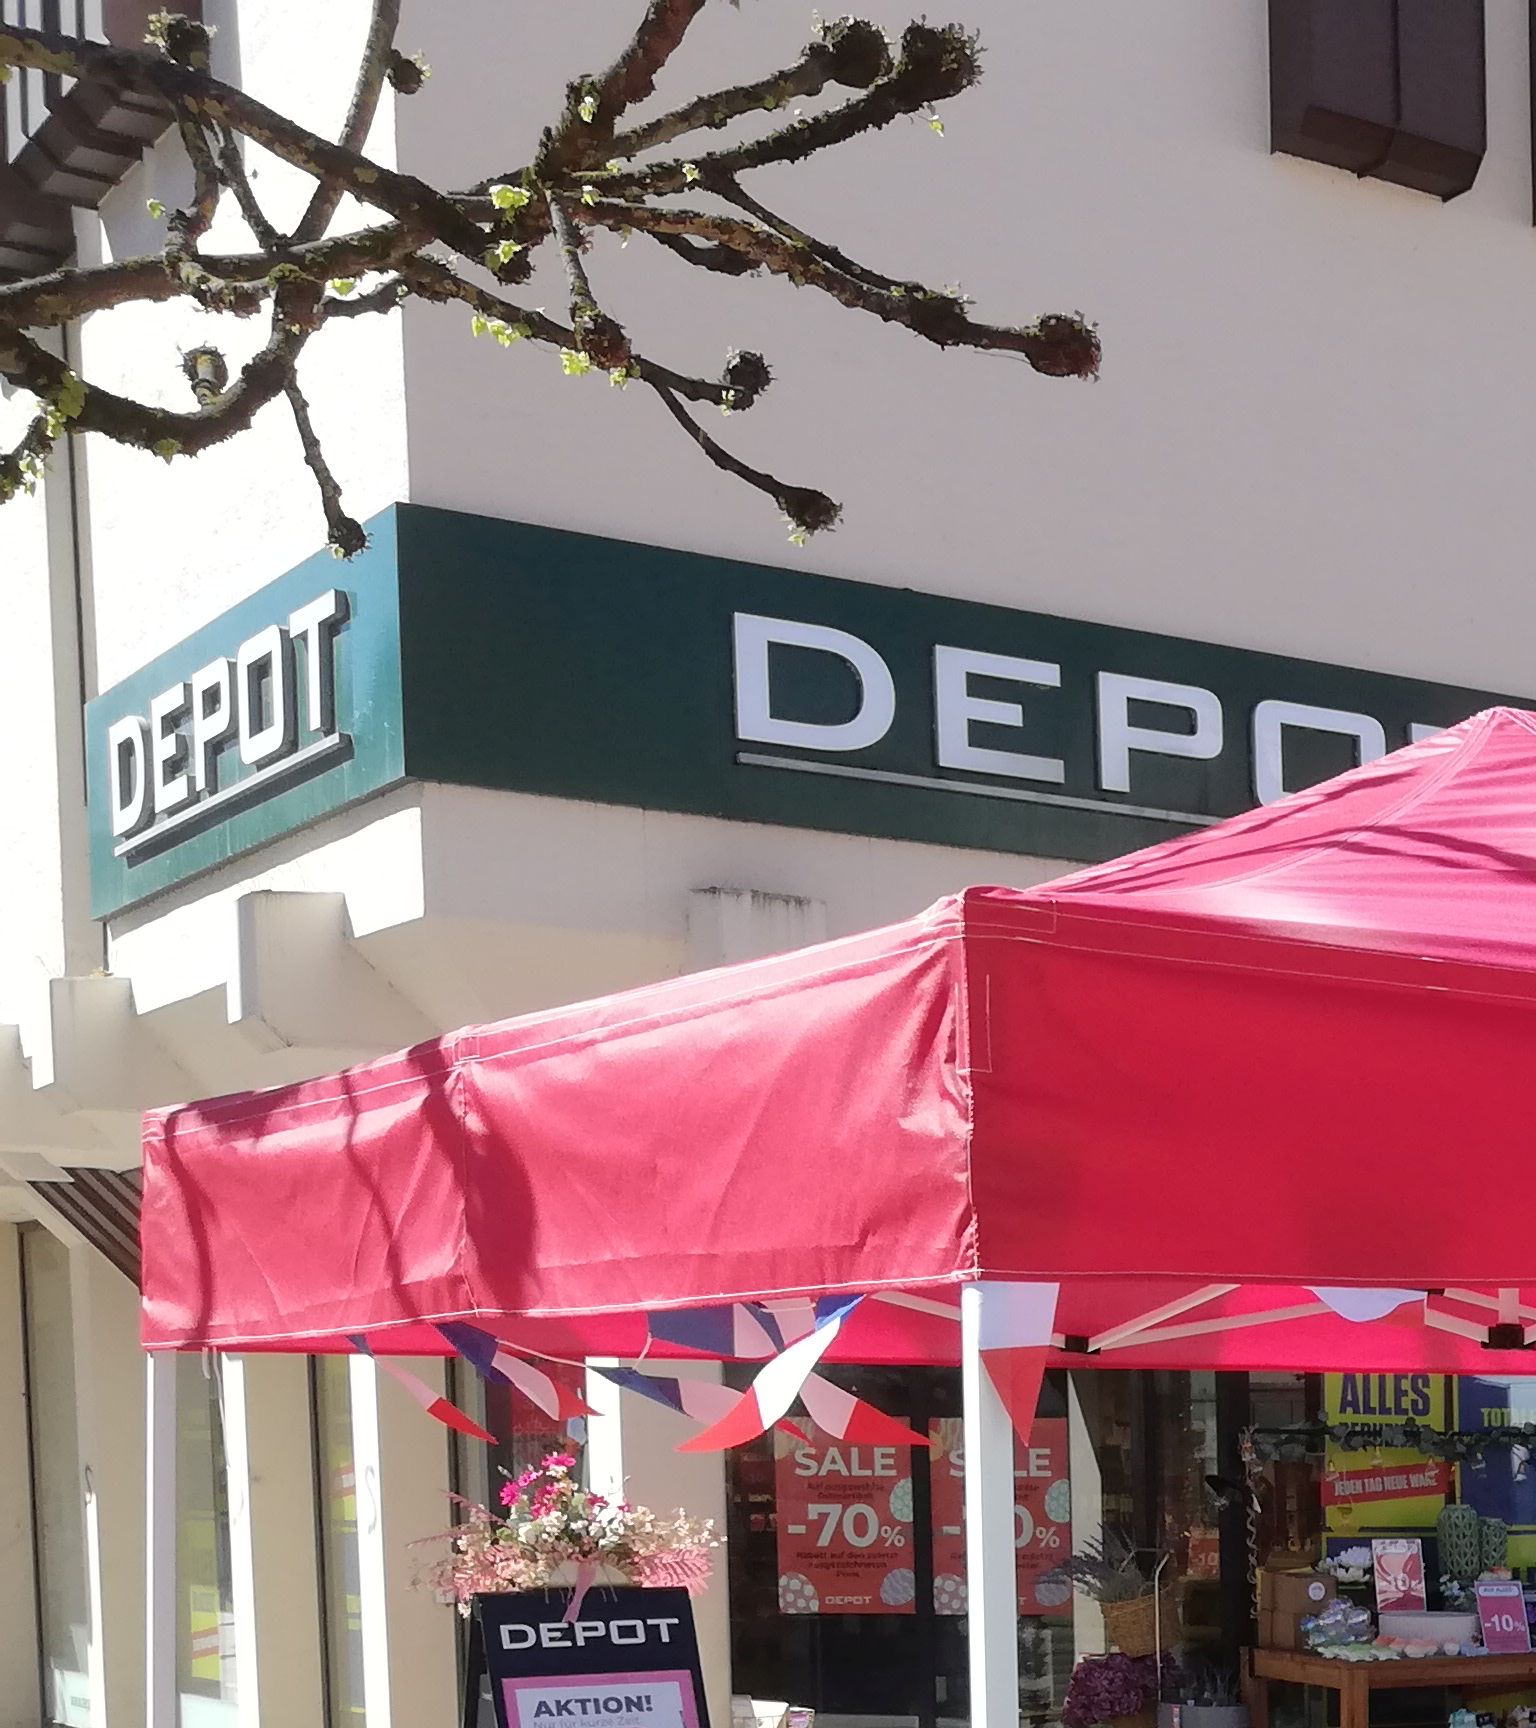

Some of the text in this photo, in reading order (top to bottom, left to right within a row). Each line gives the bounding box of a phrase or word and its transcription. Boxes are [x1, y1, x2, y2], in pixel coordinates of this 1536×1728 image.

[108, 587, 350, 839] DEPOT
[732, 610, 1446, 807] DEPO
[1339, 1374, 1430, 1417] ALLES
[794, 1447, 897, 1477] SALE
[949, 1447, 1052, 1477] SE
[787, 1503, 905, 1548] -70%
[825, 1596, 872, 1605] DEPOT
[500, 1617, 680, 1650] DEPOT
[1484, 1614, 1526, 1632] -10%
[533, 1694, 654, 1719] AKTION!
[560, 1717, 577, 1728] für
[580, 1716, 614, 1728] kurze
